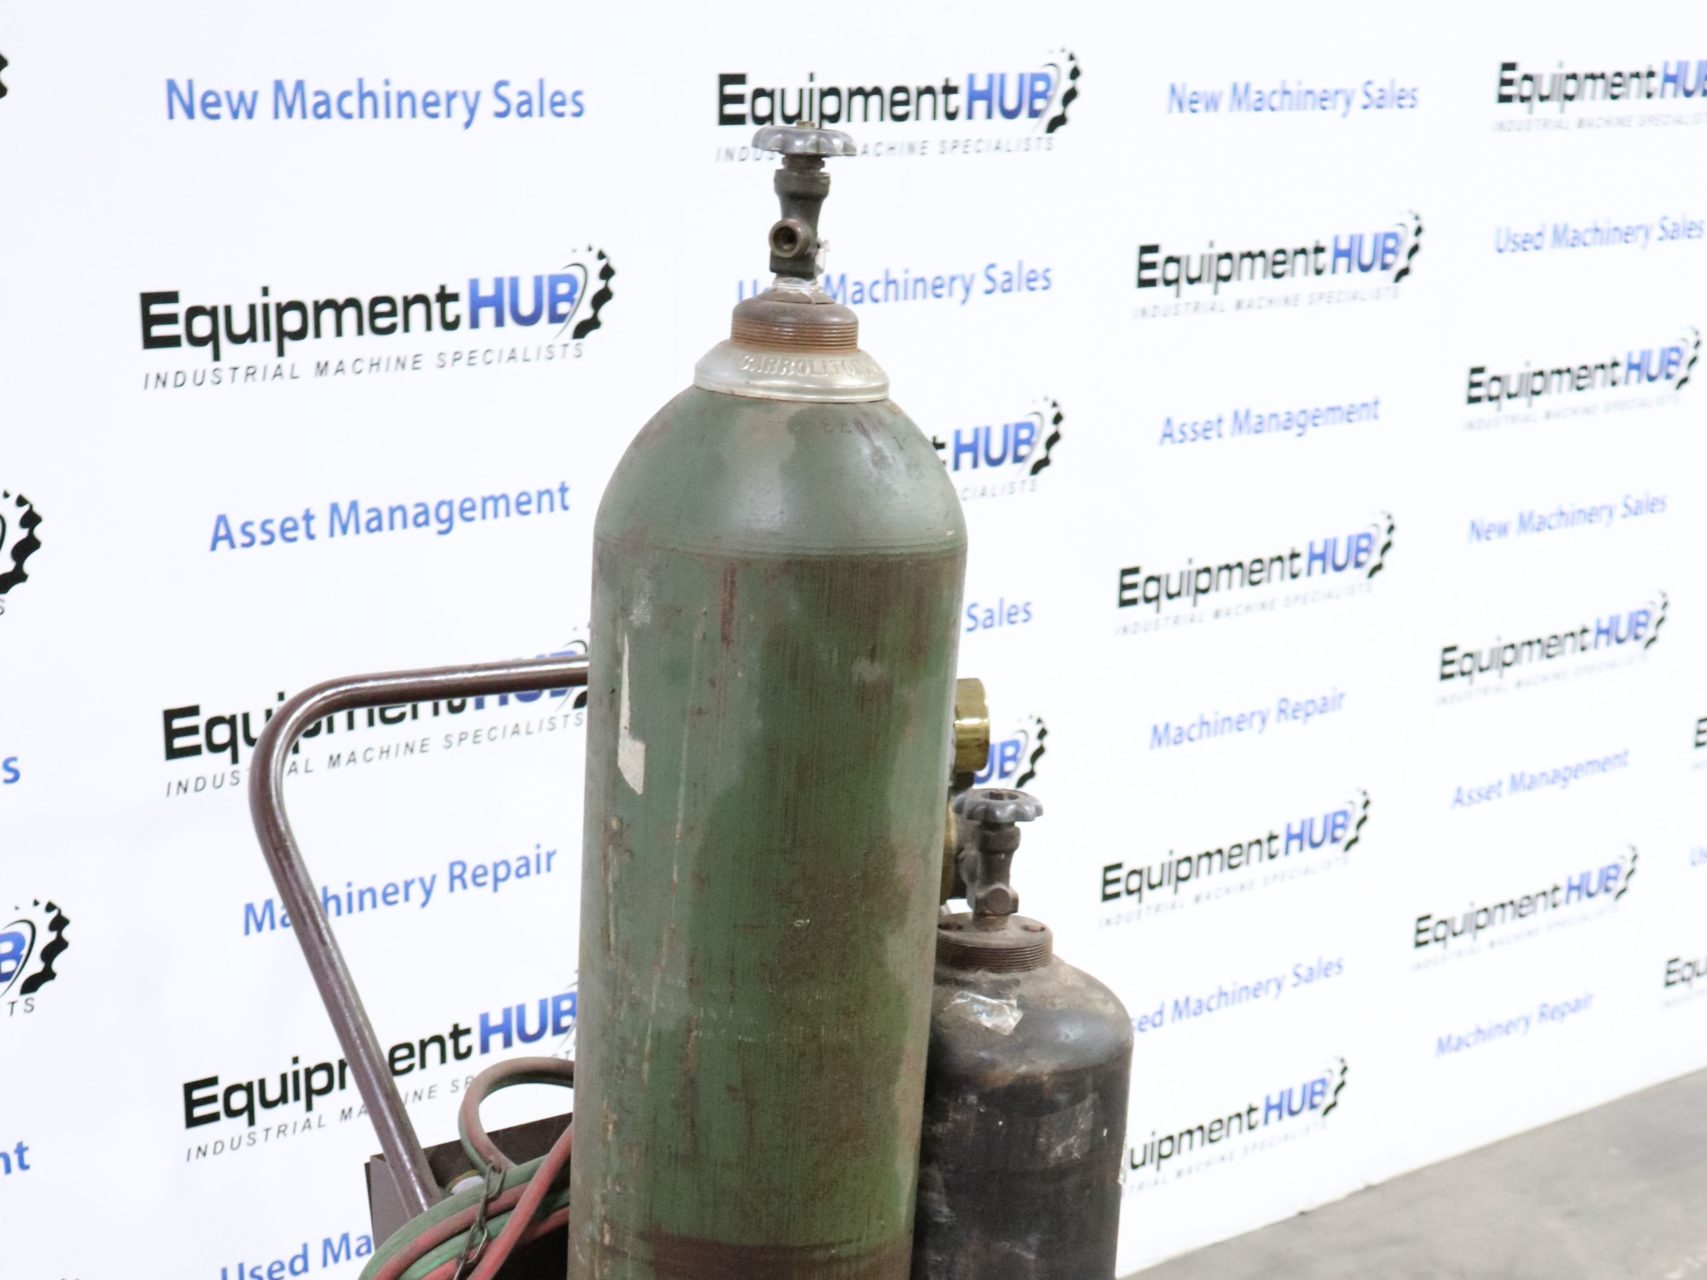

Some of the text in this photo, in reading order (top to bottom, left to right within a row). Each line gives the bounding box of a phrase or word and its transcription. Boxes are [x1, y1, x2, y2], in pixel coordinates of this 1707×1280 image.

[165, 77, 585, 129] New Machinery Sales
[1168, 79, 1419, 118] New Machinery Sales
[1498, 60, 1707, 114] EquipmentHU
[860, 141, 928, 159] ACHINE
[1496, 213, 1705, 253] Used Machinery Sales
[824, 260, 1053, 305] Machinery Sales
[144, 343, 585, 390] INDUSTRIAL MACHINE SPECIALISTS
[1159, 397, 1380, 445] Asset Management
[209, 480, 570, 552] Asset Management
[1468, 491, 1668, 543] New Machinery Sales
[965, 597, 1032, 632] Sales
[327, 736, 431, 770] MACHINE
[442, 711, 584, 750] SPECIALISTS
[1150, 686, 1345, 750] Machinery Repair
[1451, 749, 1629, 809] Asset Management
[243, 843, 557, 935] Mahinery Repair
[1171, 975, 1286, 1023] Machinery
[1291, 956, 1344, 988] Sales
[186, 1113, 328, 1162] INDUSTRIAL
